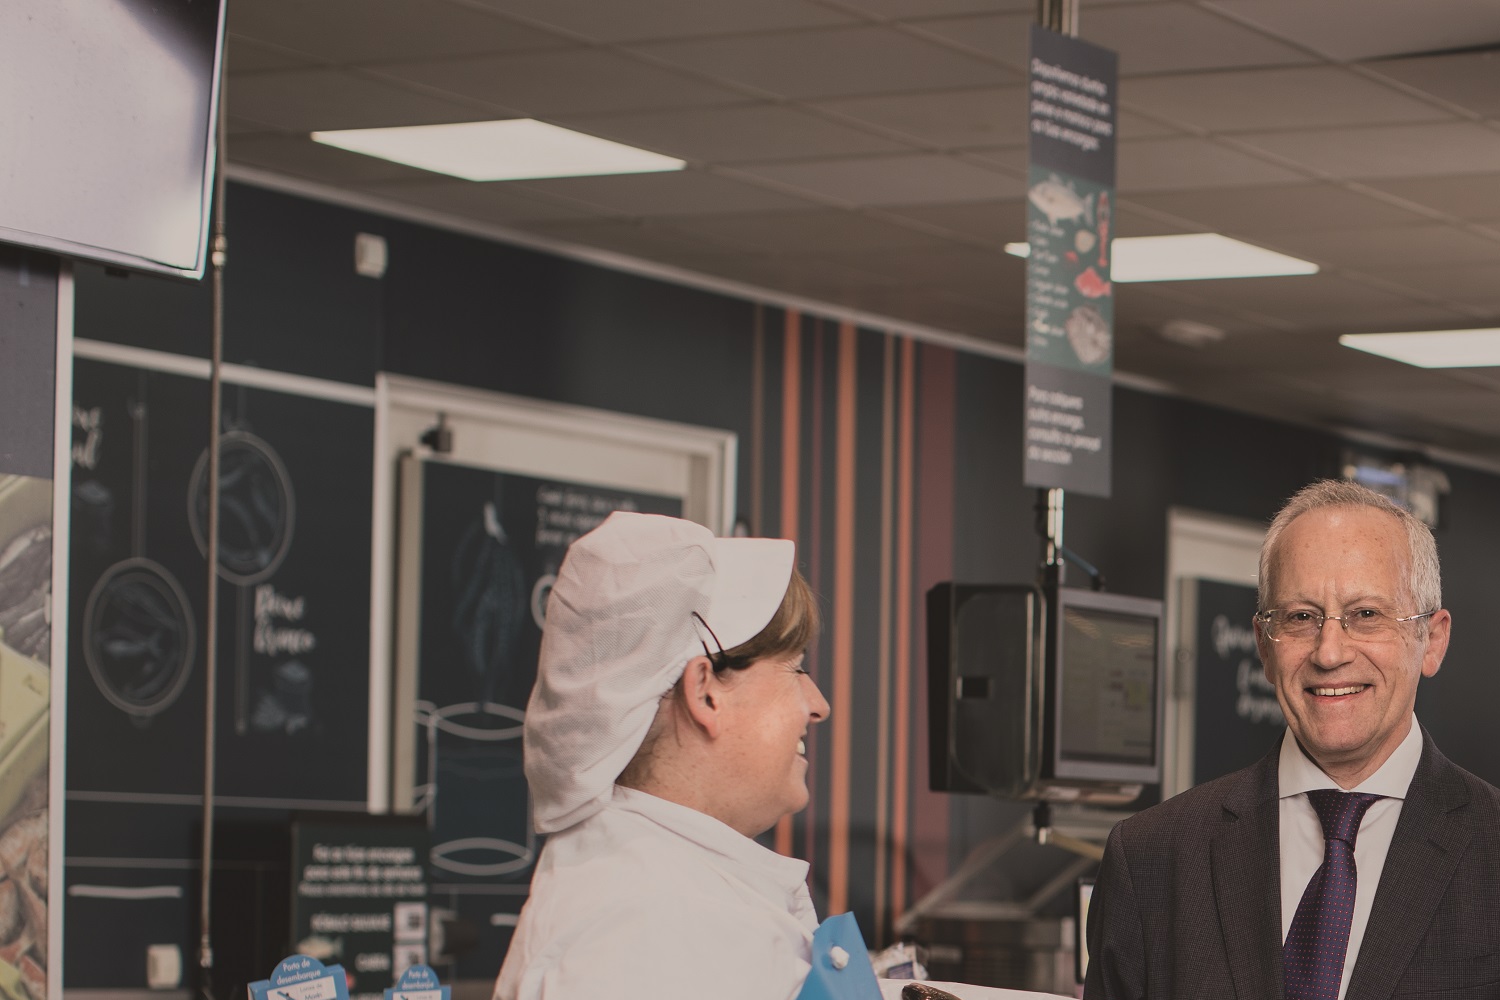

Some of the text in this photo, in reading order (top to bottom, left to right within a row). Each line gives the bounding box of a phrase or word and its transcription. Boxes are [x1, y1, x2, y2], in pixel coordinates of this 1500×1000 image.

[282, 958, 311, 972] Porto de
[277, 968, 321, 986] desembarque
